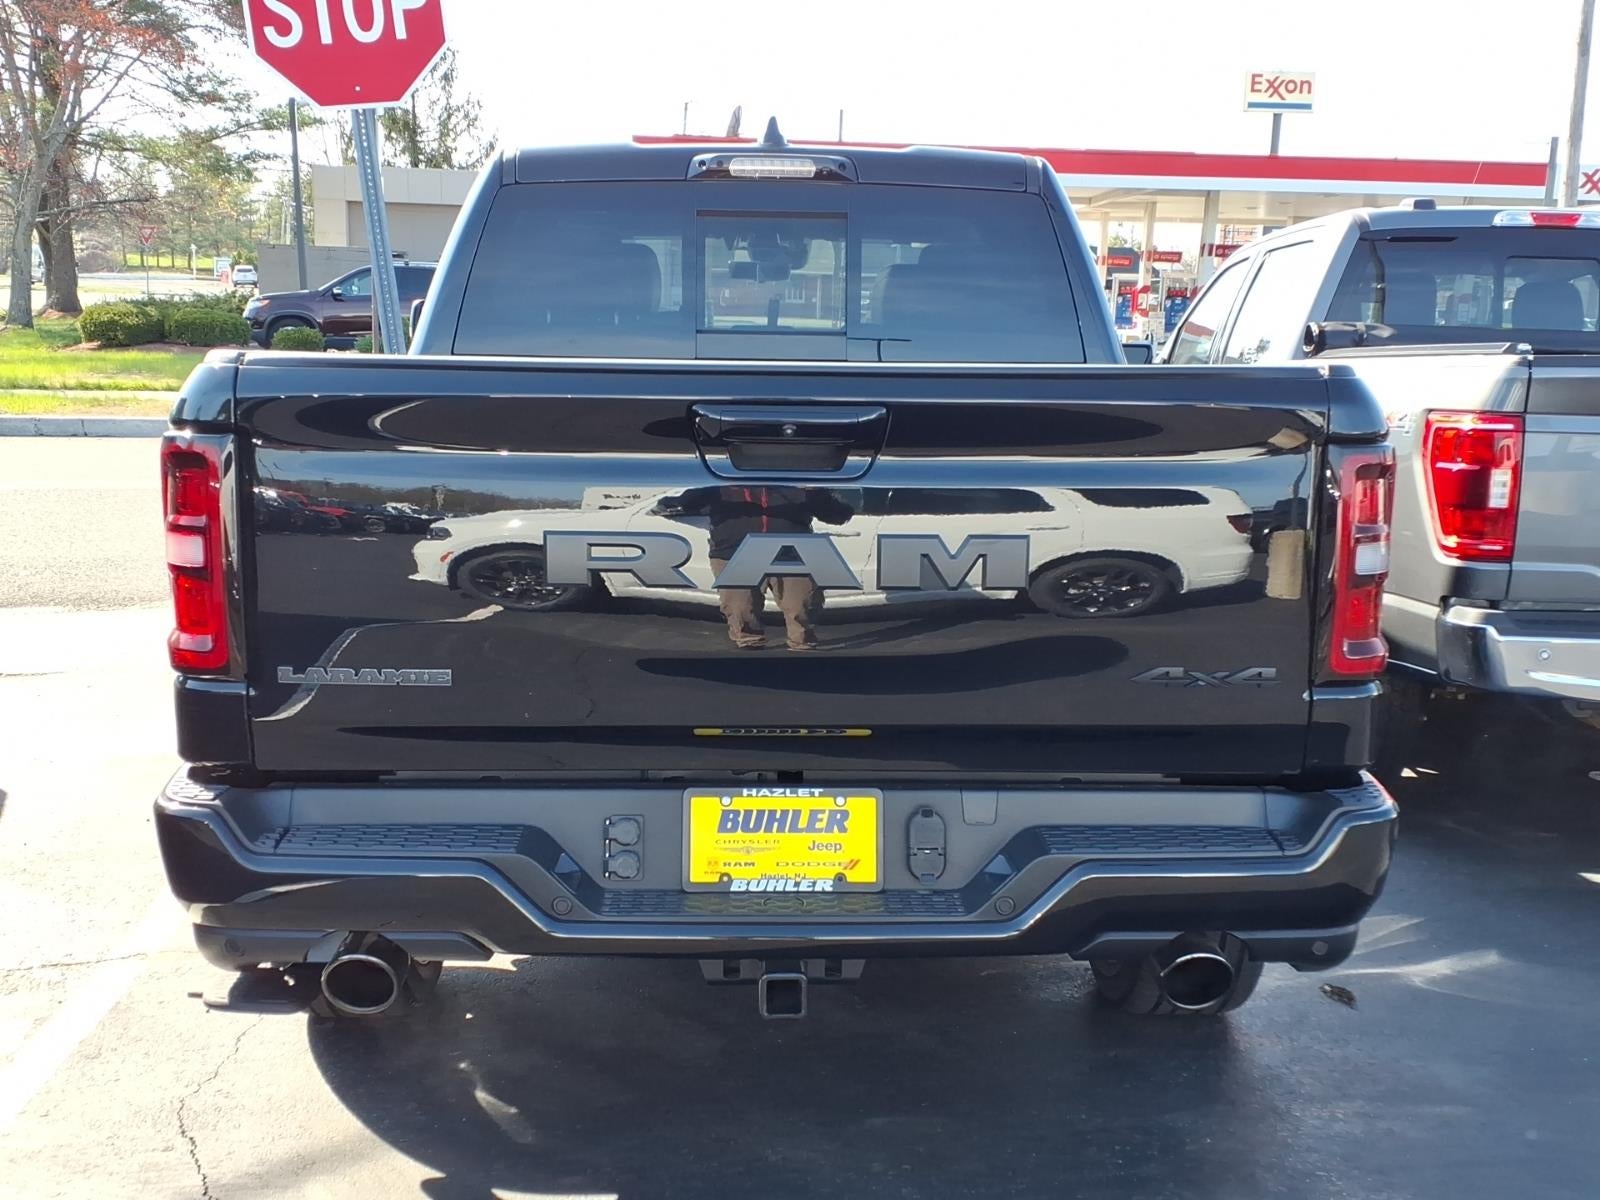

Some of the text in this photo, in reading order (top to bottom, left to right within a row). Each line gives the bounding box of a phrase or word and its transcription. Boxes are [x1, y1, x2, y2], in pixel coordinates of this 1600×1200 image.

[1250, 73, 1313, 101] Exxon
[543, 530, 1031, 591] RAM
[277, 666, 452, 686] LARAMIE
[742, 788, 824, 797] HAZLET
[717, 808, 850, 834] BUHLER
[807, 840, 843, 853] Jeep
[730, 879, 834, 892] BUHLER
